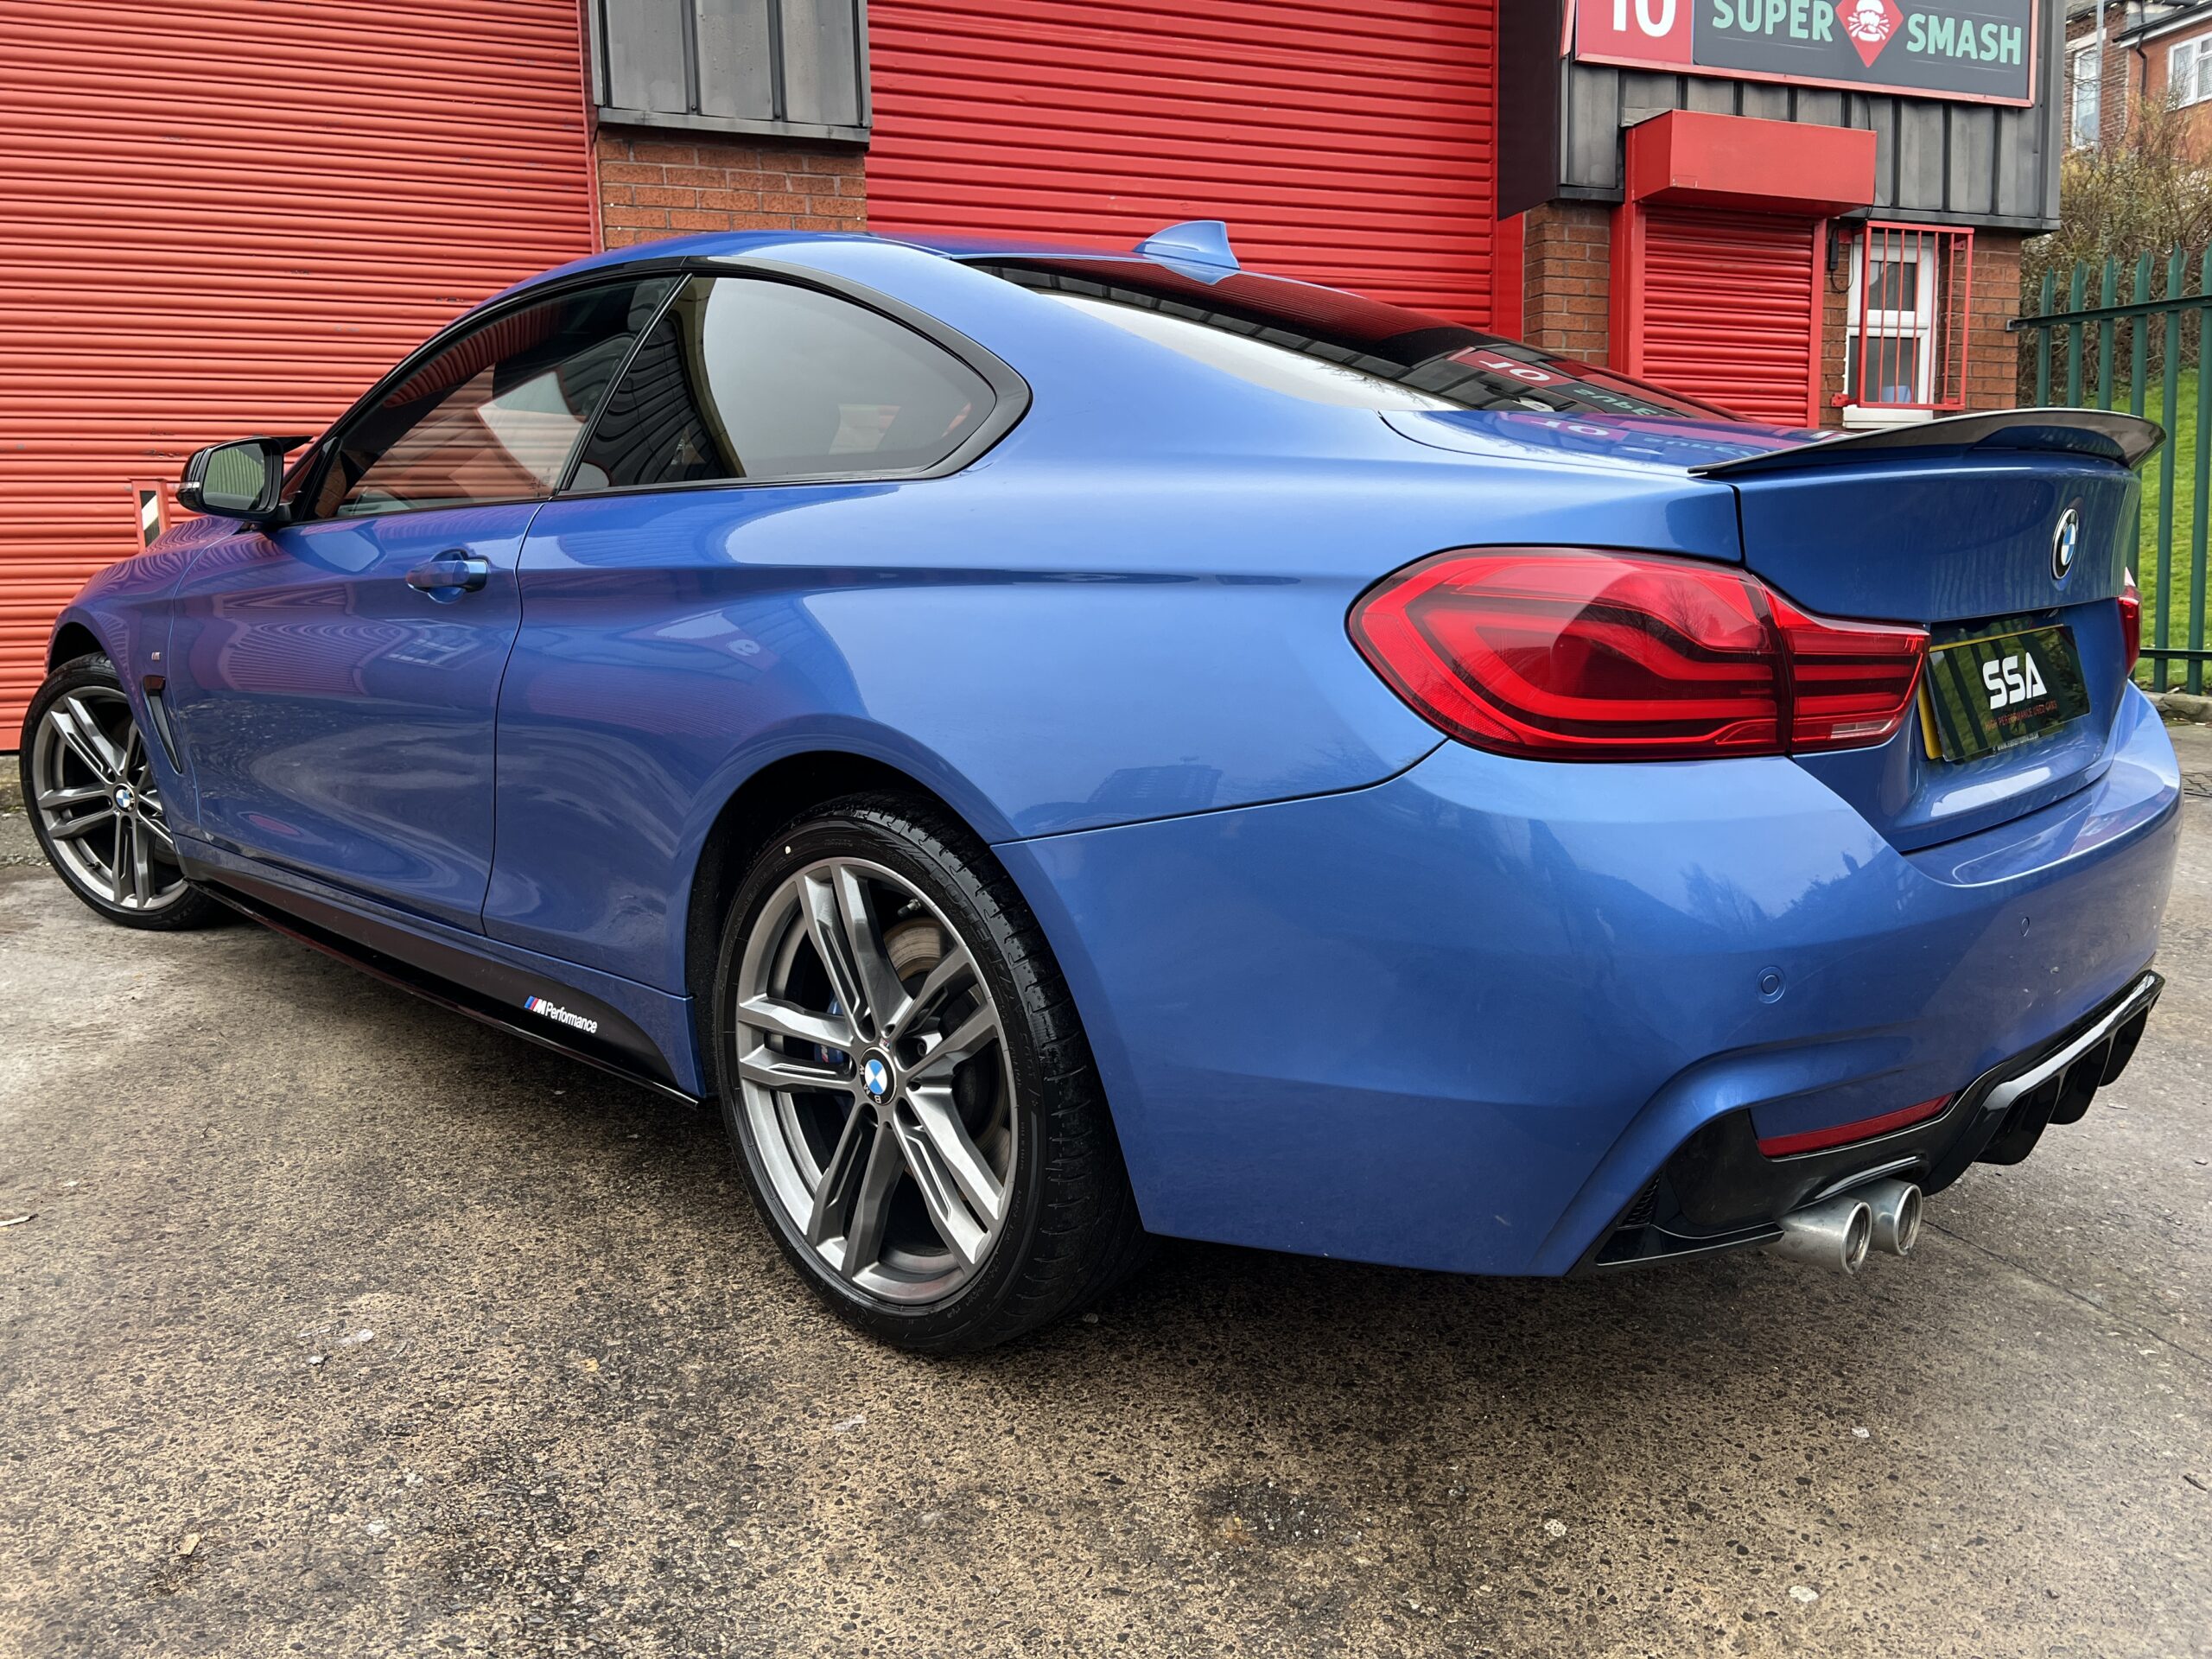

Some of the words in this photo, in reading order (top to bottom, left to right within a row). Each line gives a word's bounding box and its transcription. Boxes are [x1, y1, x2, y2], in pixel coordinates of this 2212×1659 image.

[1712, 0, 1834, 41] SUPER
[1906, 14, 2021, 65] SMASH
[1982, 652, 2047, 709] SSA
[545, 1001, 598, 1033] Performance
